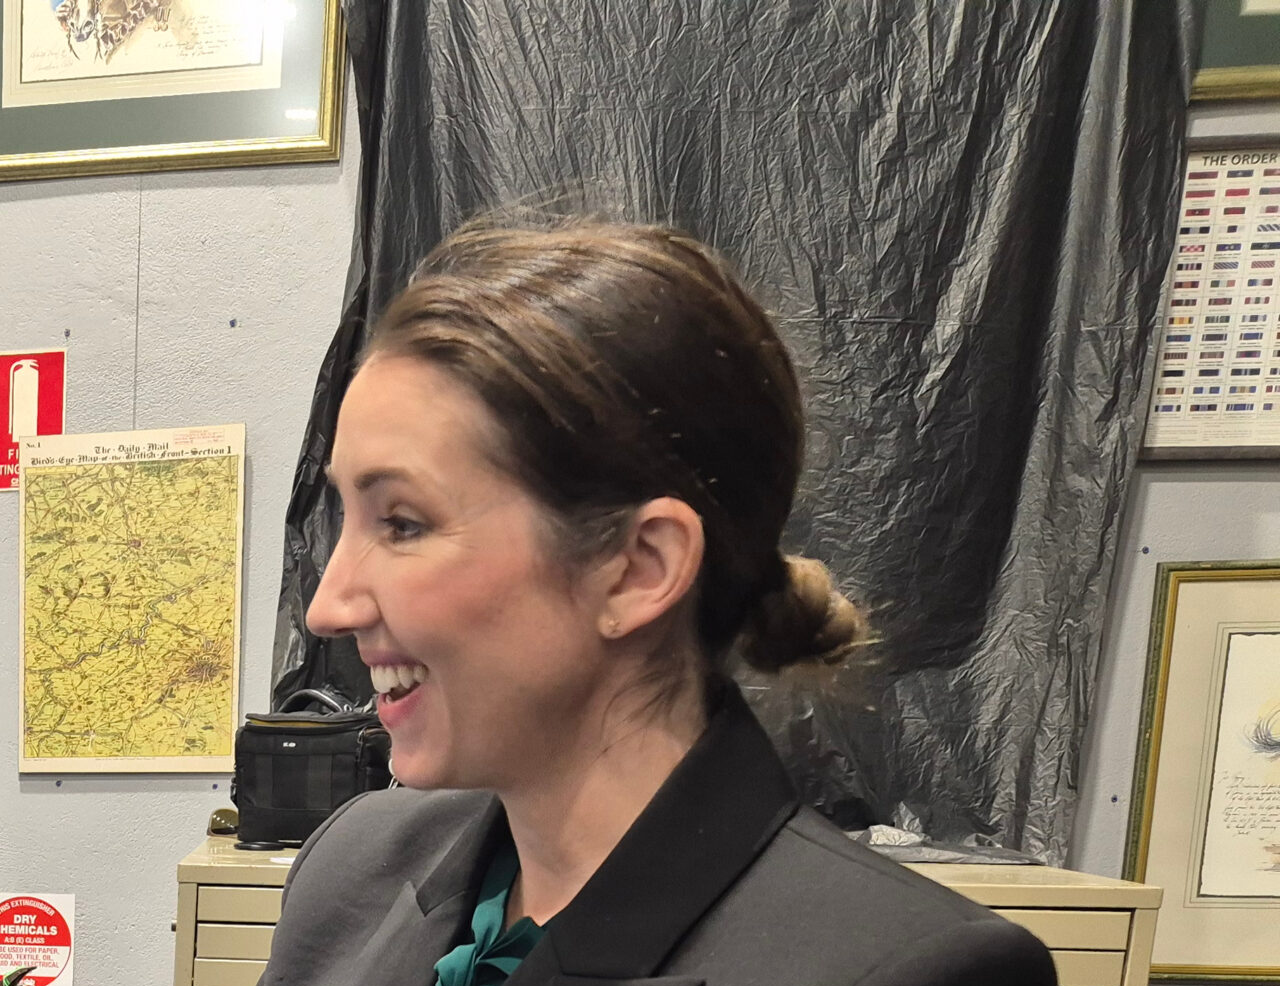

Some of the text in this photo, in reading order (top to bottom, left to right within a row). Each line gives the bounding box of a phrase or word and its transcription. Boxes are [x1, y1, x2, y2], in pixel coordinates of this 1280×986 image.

[1202, 153, 1278, 167] THE ORDER
[8, 448, 19, 460] FI
[94, 443, 169, 454] The Daily Mail
[13, 914, 37, 924] DRY
